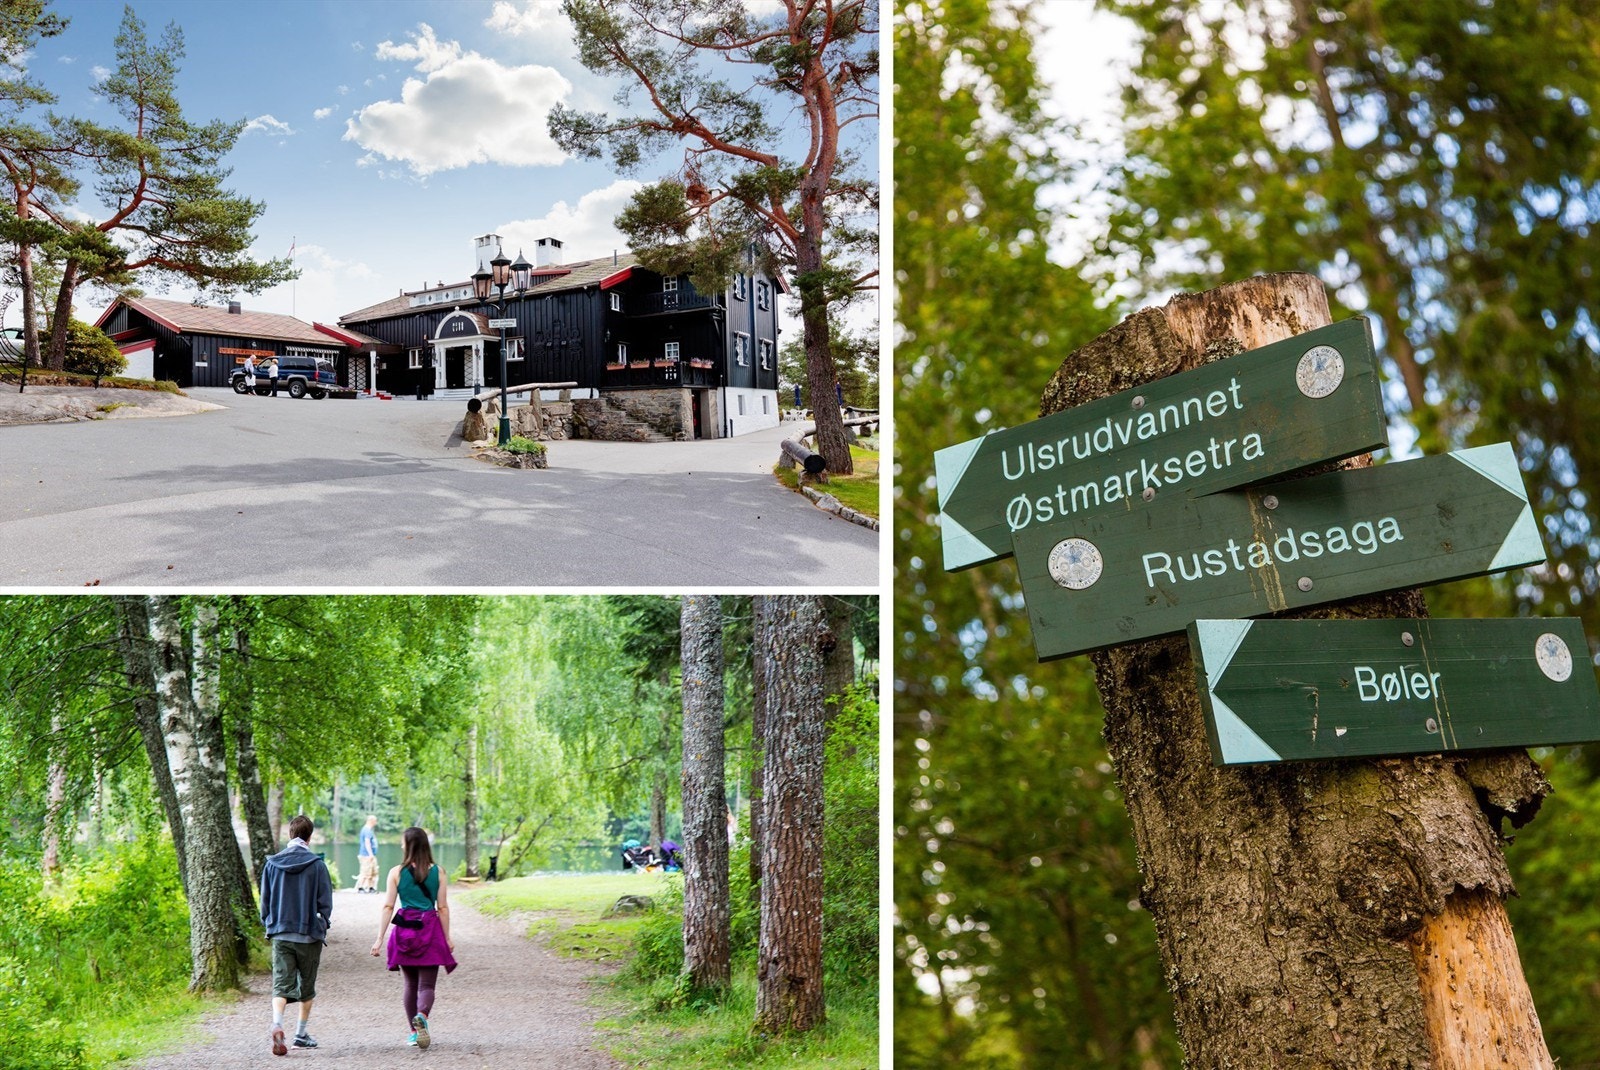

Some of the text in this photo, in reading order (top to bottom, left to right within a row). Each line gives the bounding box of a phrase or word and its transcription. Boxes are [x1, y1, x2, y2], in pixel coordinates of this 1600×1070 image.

[1001, 377, 1244, 481] Ulsrudvannet
[1006, 432, 1265, 533] Østmarksetra
[1074, 540, 1096, 554] OMEGN
[1141, 516, 1405, 588] Rustadsaga
[1353, 664, 1442, 702] Bøler
